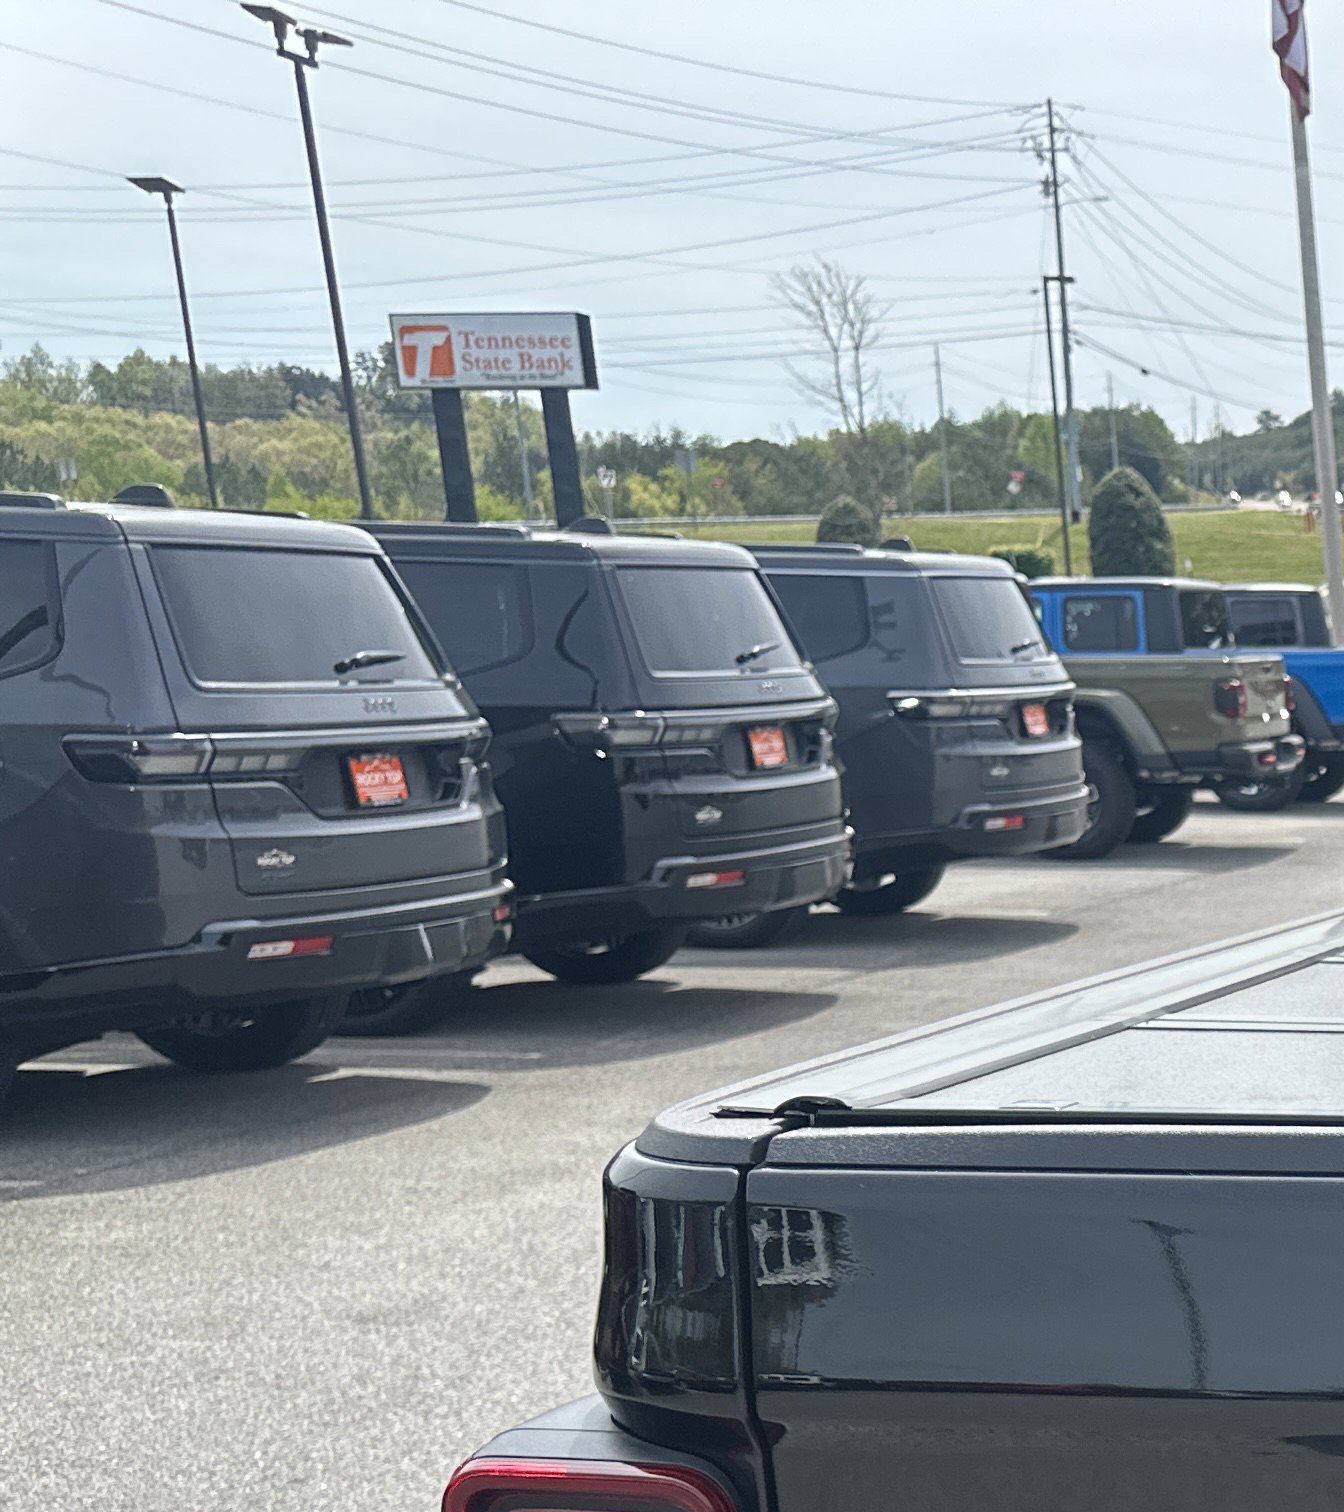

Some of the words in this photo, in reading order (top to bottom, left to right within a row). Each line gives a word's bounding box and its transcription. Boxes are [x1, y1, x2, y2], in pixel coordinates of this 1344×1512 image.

[458, 330, 572, 350] Tennessee
[462, 352, 512, 371] State
[518, 352, 573, 372] Bank
